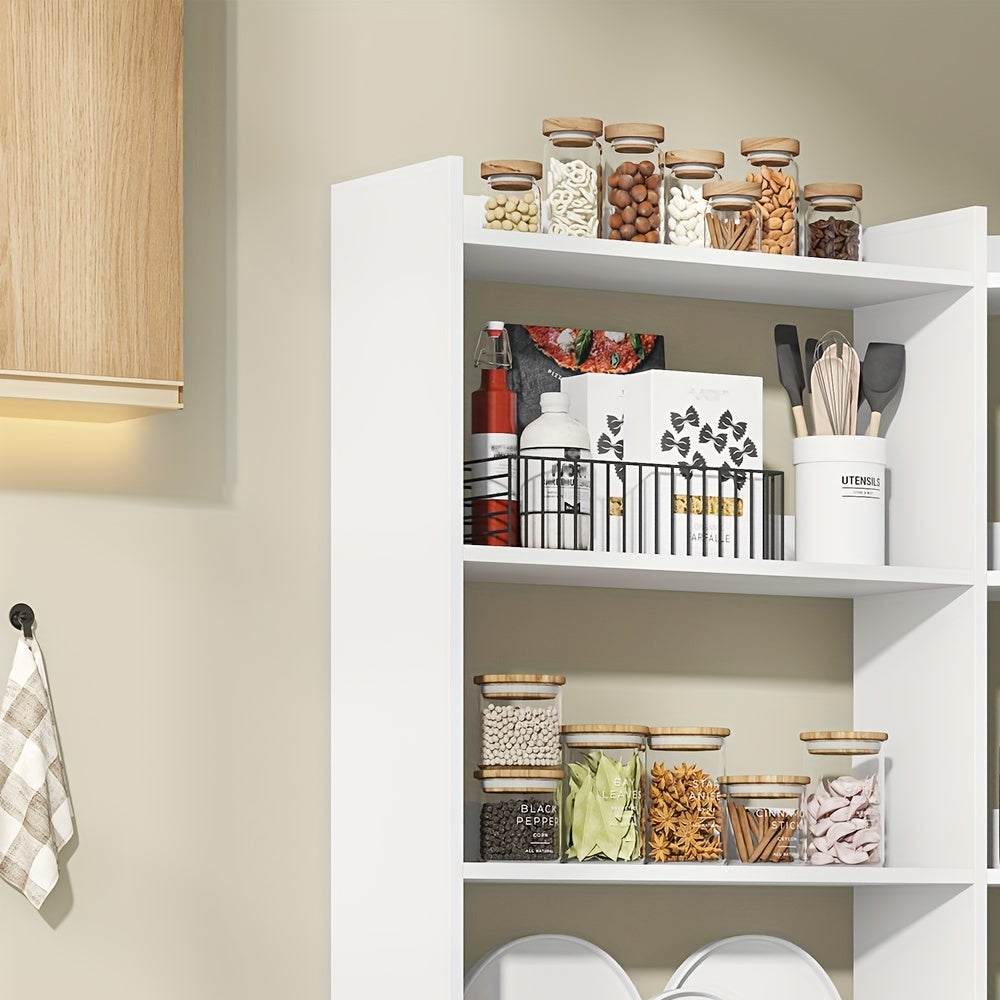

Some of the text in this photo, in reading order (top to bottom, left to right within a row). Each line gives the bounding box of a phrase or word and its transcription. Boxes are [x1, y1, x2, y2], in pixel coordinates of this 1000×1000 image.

[841, 475, 881, 487] UTENSILS
[614, 777, 636, 788] BAY
[602, 790, 642, 800] LEAVES
[689, 791, 721, 801] ANISE
[520, 804, 557, 814] BLACK
[516, 816, 560, 827] PEPPER
